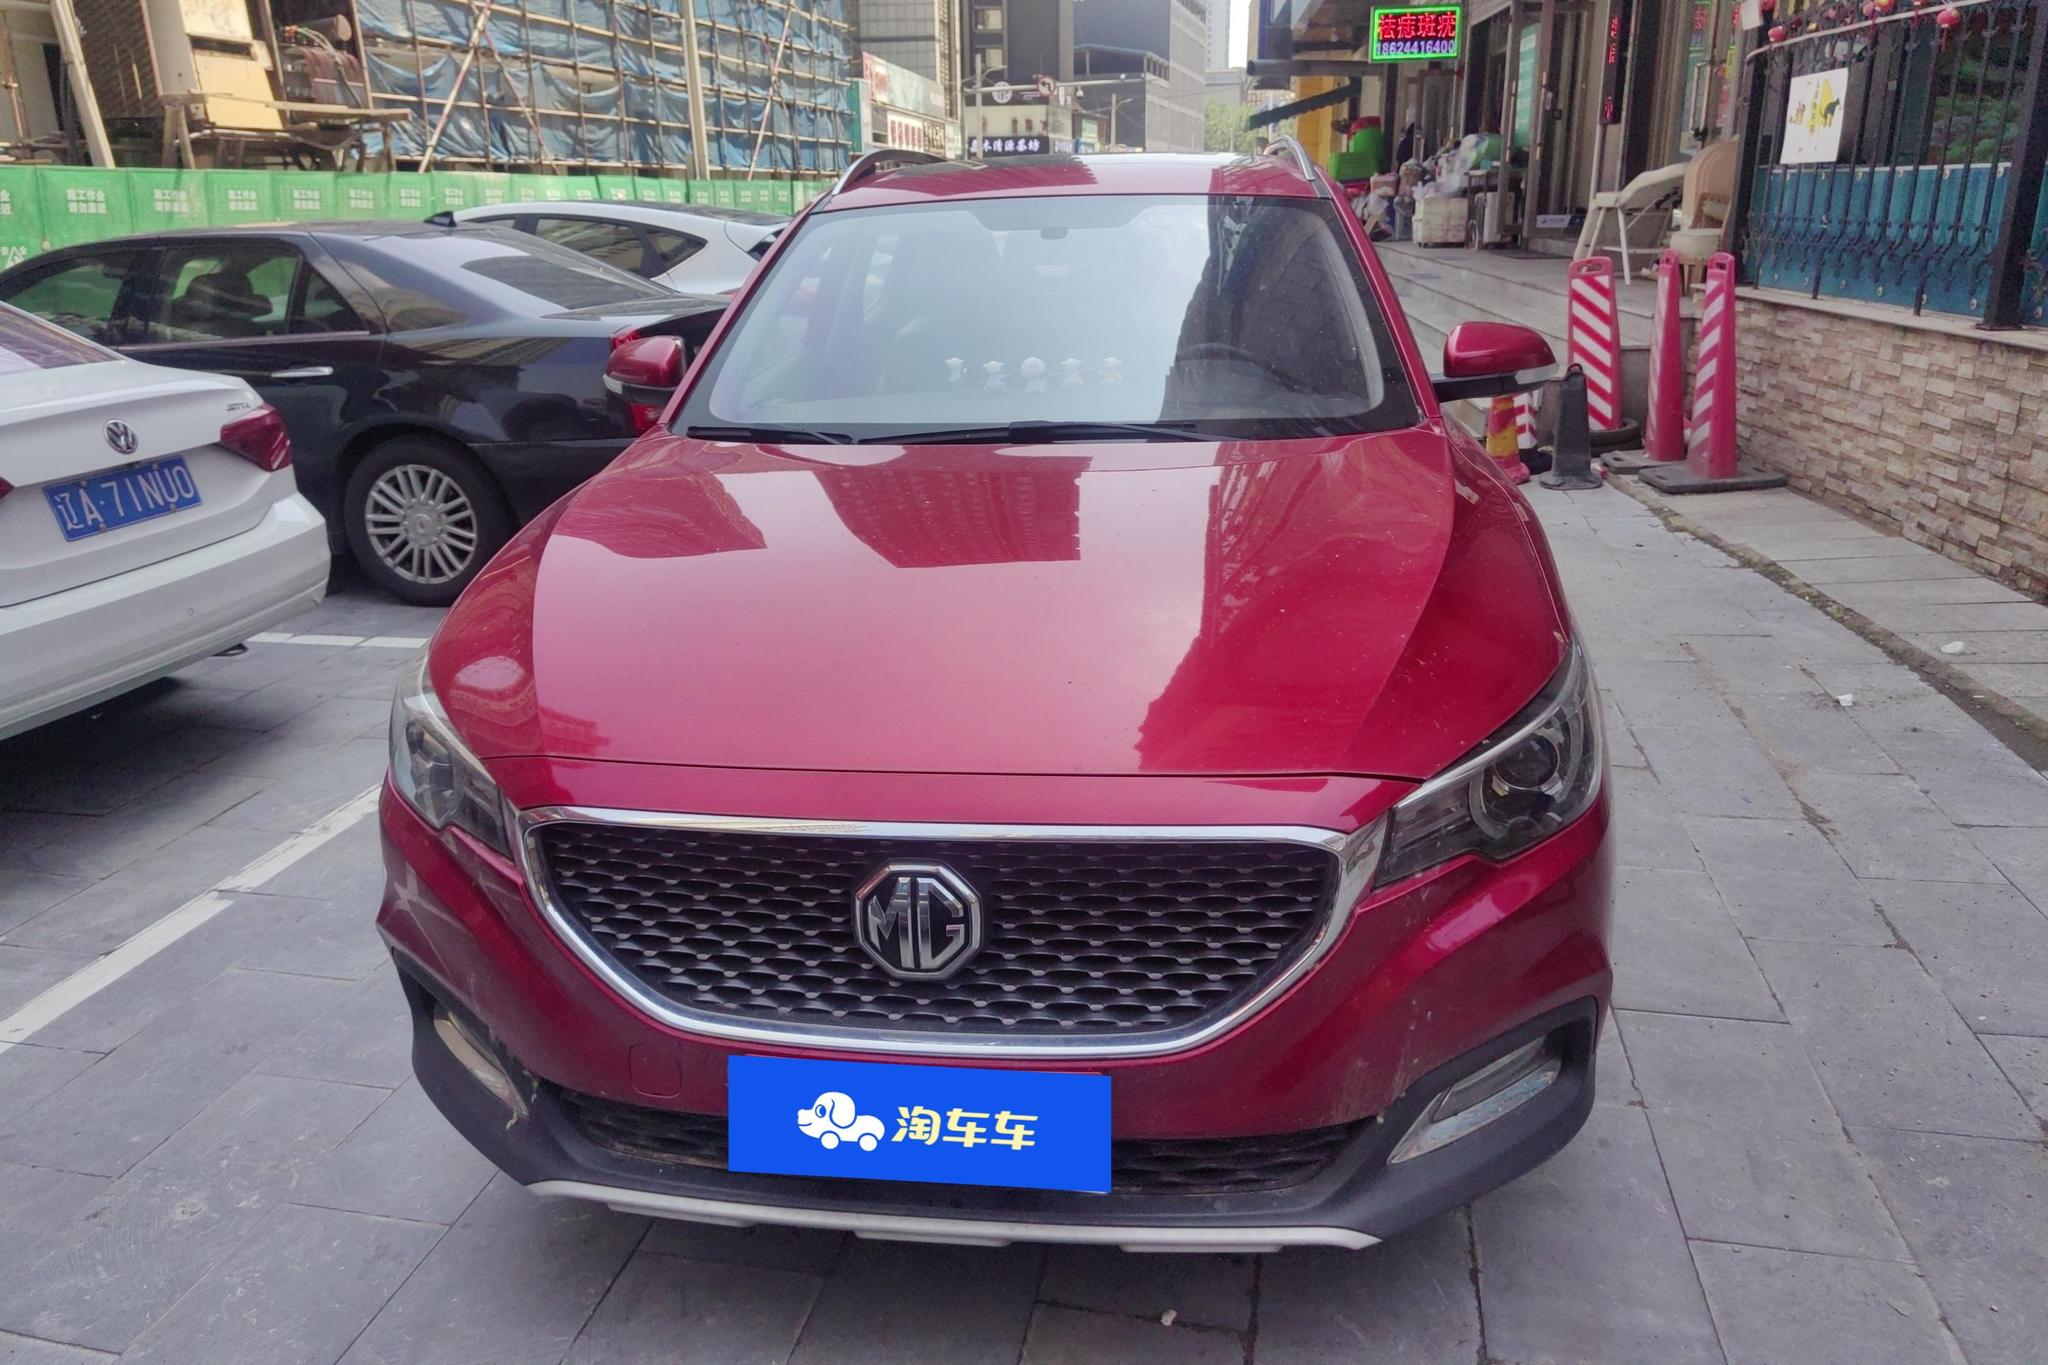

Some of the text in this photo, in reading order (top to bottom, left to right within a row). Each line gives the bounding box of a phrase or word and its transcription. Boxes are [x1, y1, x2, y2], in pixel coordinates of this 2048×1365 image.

[1378, 11, 1456, 40] 祛痣斑疣
[1376, 40, 1456, 56] 18624416400
[867, 877, 964, 970] MG
